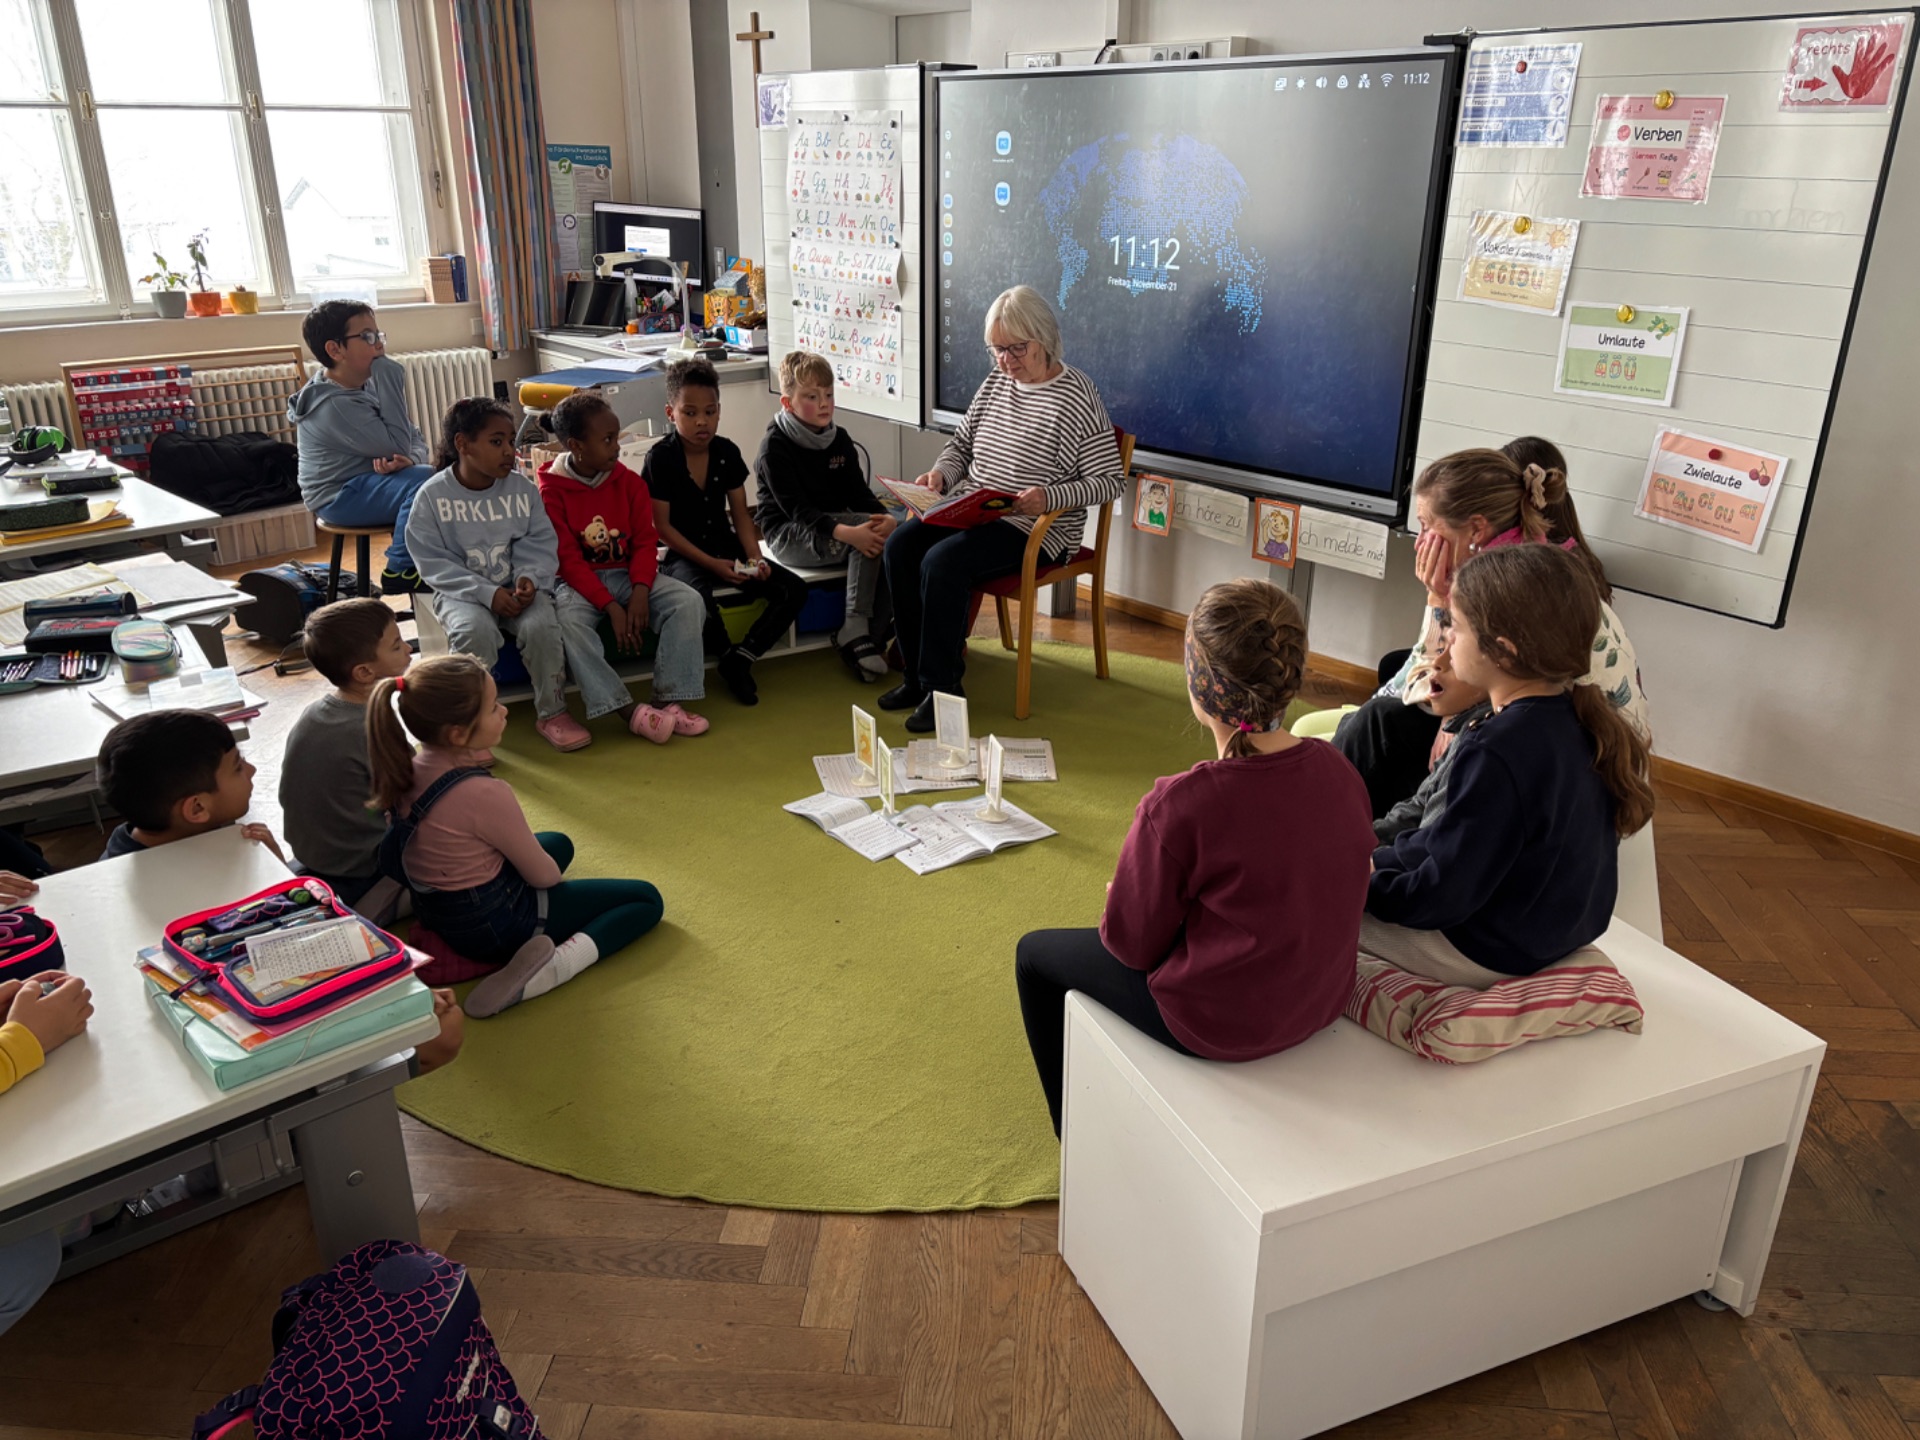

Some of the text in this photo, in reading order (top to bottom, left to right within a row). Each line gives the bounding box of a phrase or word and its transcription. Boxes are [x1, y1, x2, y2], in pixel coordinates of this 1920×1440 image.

[1806, 43, 1851, 56] rechts
[1403, 72, 1430, 85] 11:12
[1634, 126, 1683, 142] Verben
[1110, 235, 1180, 270] 11:12
[1483, 240, 1514, 256] Vokale
[1132, 279, 1167, 291] November
[1168, 282, 1178, 291] 21
[1598, 333, 1646, 348] Umlaute
[856, 367, 861, 379] 7
[875, 371, 881, 385] 9
[886, 374, 896, 387] 10
[1683, 463, 1743, 490] Zwielaute
[436, 493, 531, 522] BRKLYN
[1174, 492, 1191, 516] Ich
[1196, 497, 1221, 524] höre
[1654, 477, 1676, 495] au
[1698, 492, 1716, 510] ei
[1714, 505, 1735, 523] eu
[1299, 520, 1318, 547] Ich
[1324, 531, 1363, 557] melde
